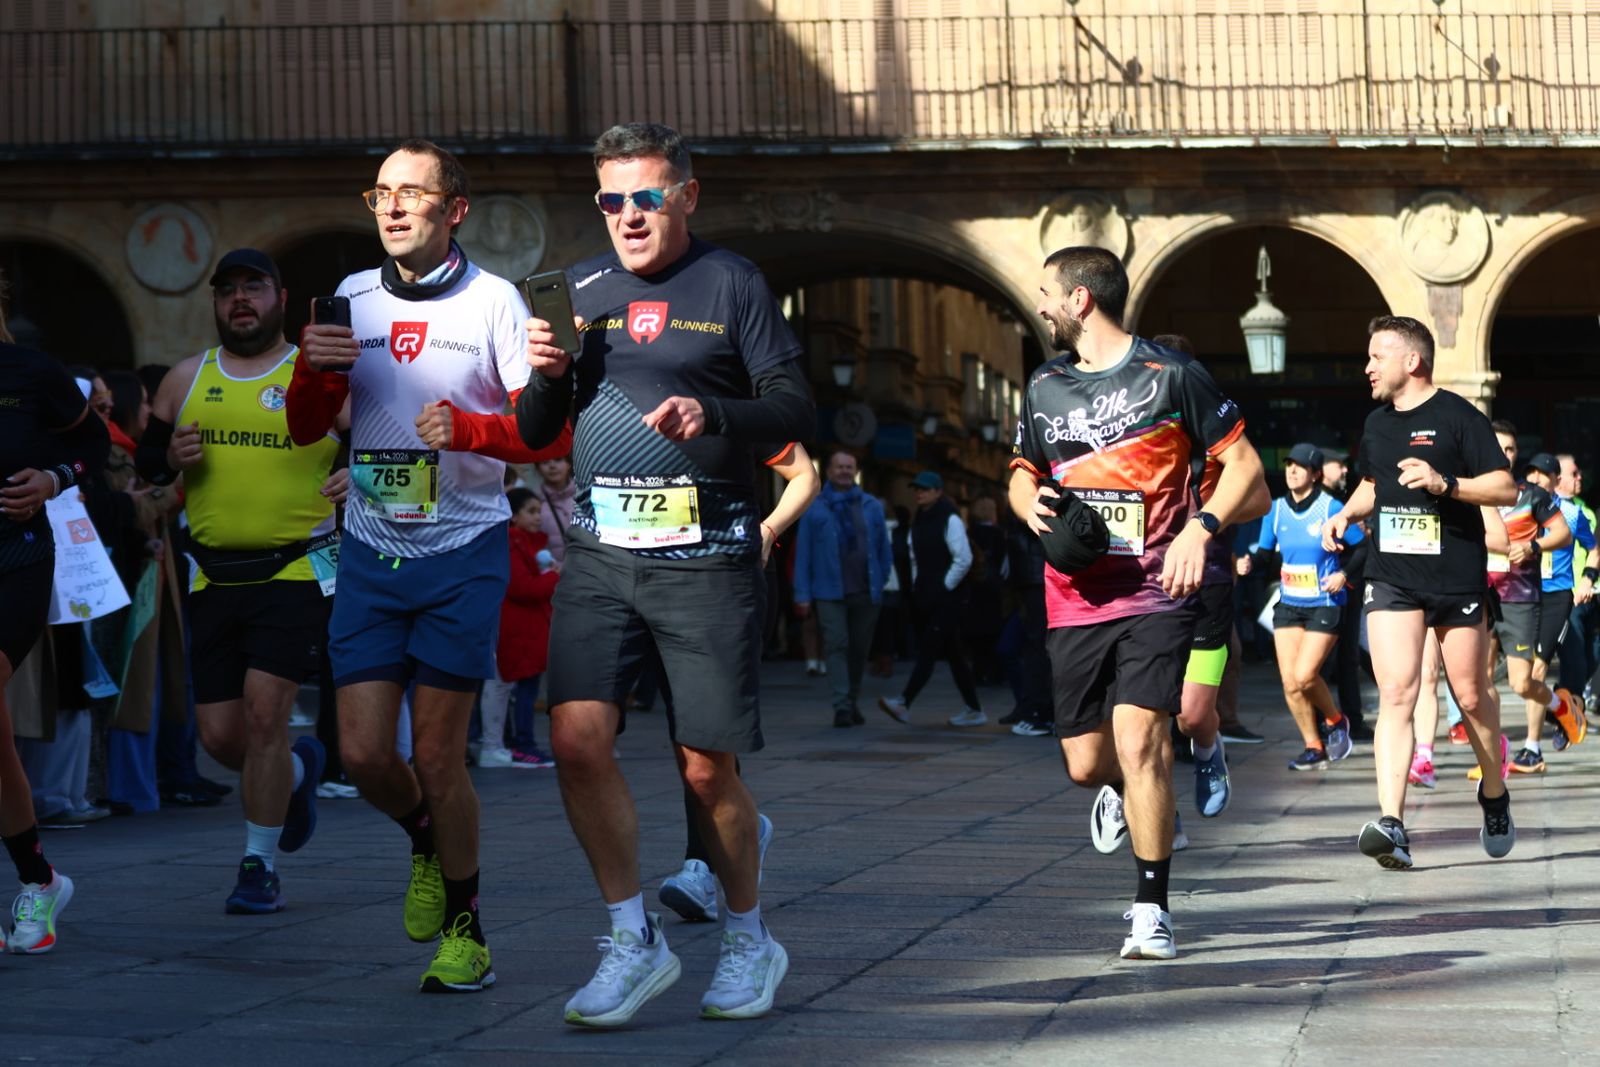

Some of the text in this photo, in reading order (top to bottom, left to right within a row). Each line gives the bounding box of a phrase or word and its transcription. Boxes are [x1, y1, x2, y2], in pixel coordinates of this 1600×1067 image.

[670, 319, 725, 335] RUNNERS
[429, 338, 482, 357] RUNNERS
[372, 468, 411, 487] 765
[645, 476, 664, 484] 2026
[618, 493, 668, 512] 772
[1103, 491, 1120, 499] 2026
[1390, 516, 1427, 530] 1775
